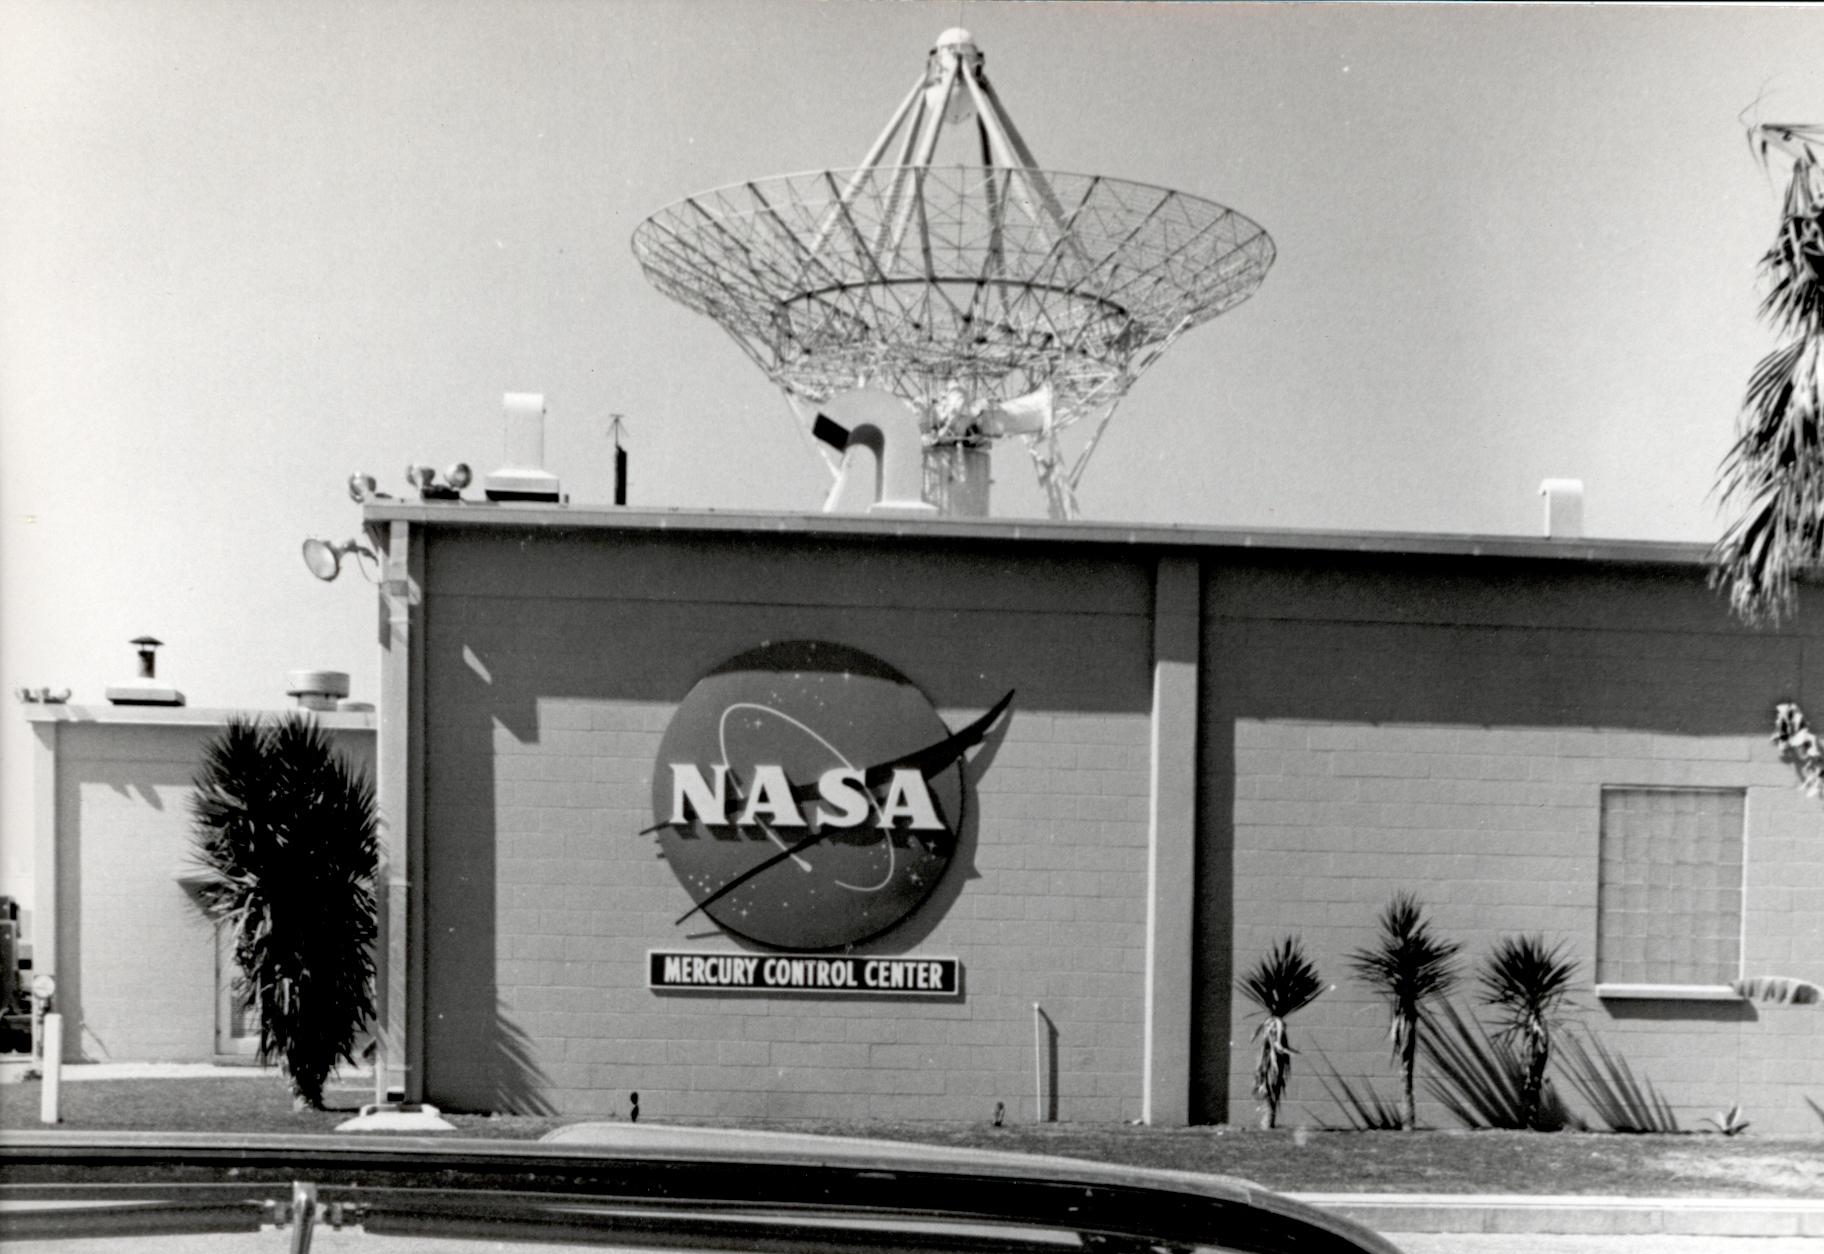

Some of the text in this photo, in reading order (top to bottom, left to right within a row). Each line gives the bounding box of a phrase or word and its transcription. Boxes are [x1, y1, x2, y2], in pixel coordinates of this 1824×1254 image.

[668, 762, 946, 830] NASA
[663, 956, 944, 990] MERCURY CONTROL CENTER
